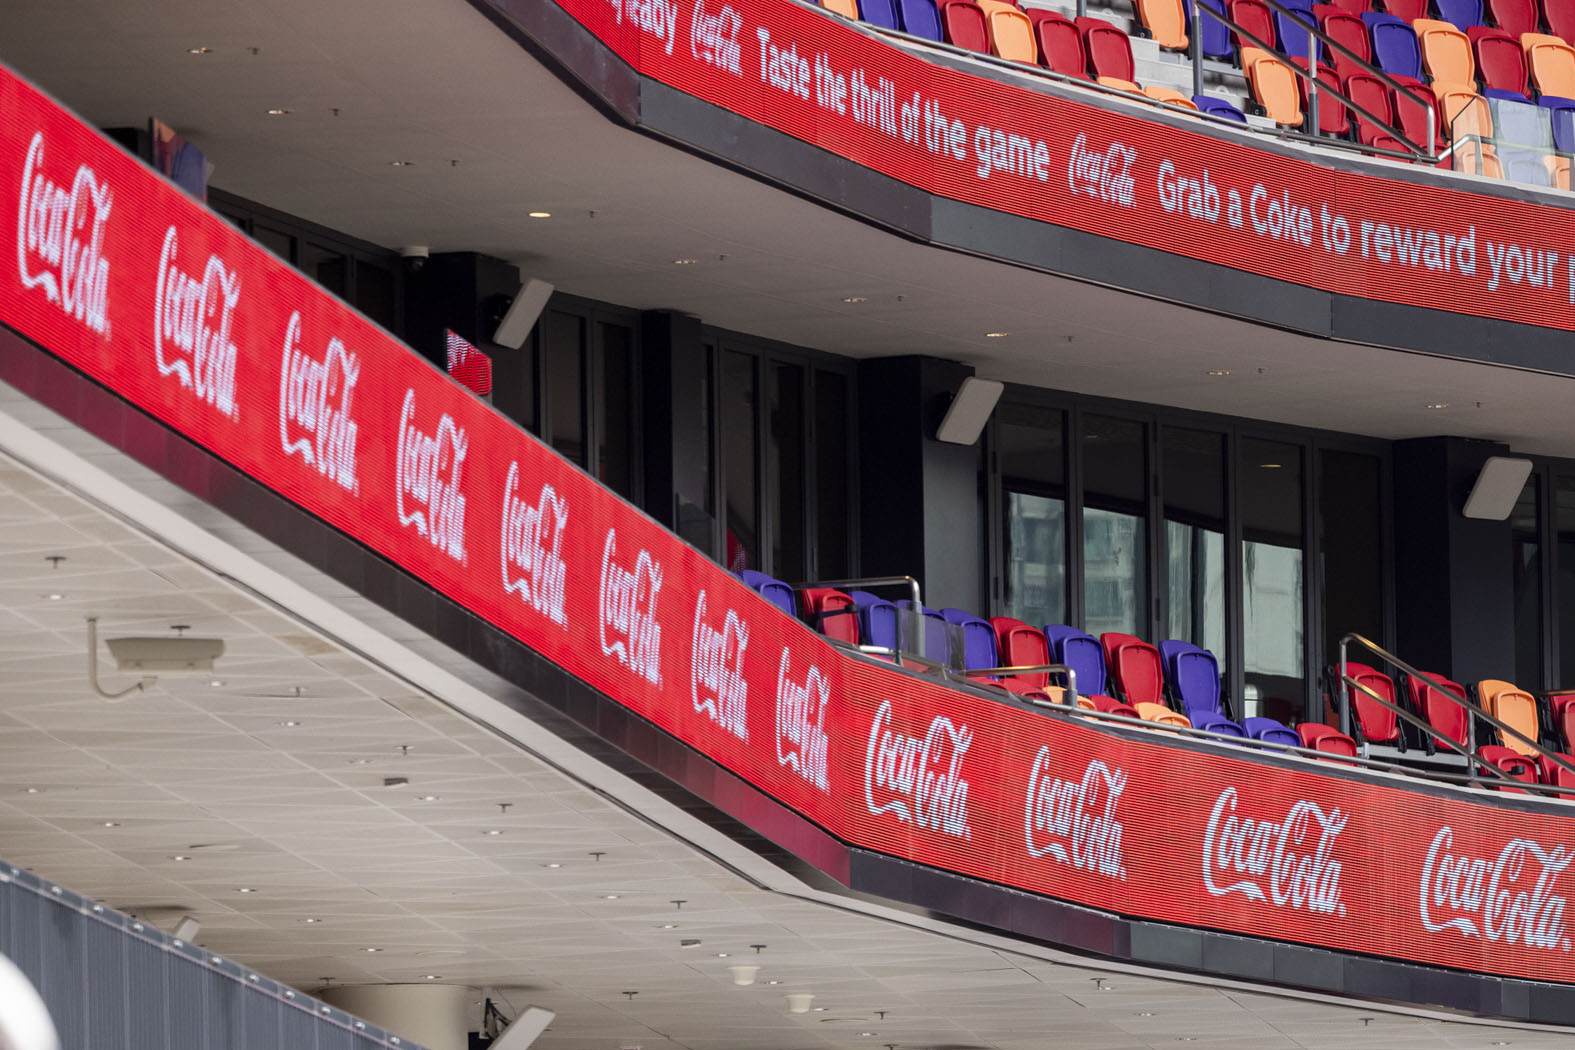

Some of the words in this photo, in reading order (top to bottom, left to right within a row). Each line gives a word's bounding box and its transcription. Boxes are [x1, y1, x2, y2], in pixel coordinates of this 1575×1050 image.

[757, 27, 810, 100] Taste
[815, 52, 846, 115] the
[852, 68, 897, 137] thrill
[900, 91, 922, 146] of
[925, 99, 967, 160] the
[975, 125, 1049, 182] game
[1158, 159, 1220, 223] Grab
[1228, 187, 1243, 228] a
[1250, 183, 1313, 248] Coke
[1320, 203, 1351, 254] to
[1360, 219, 1476, 276] reward
[1487, 239, 1560, 292] your
